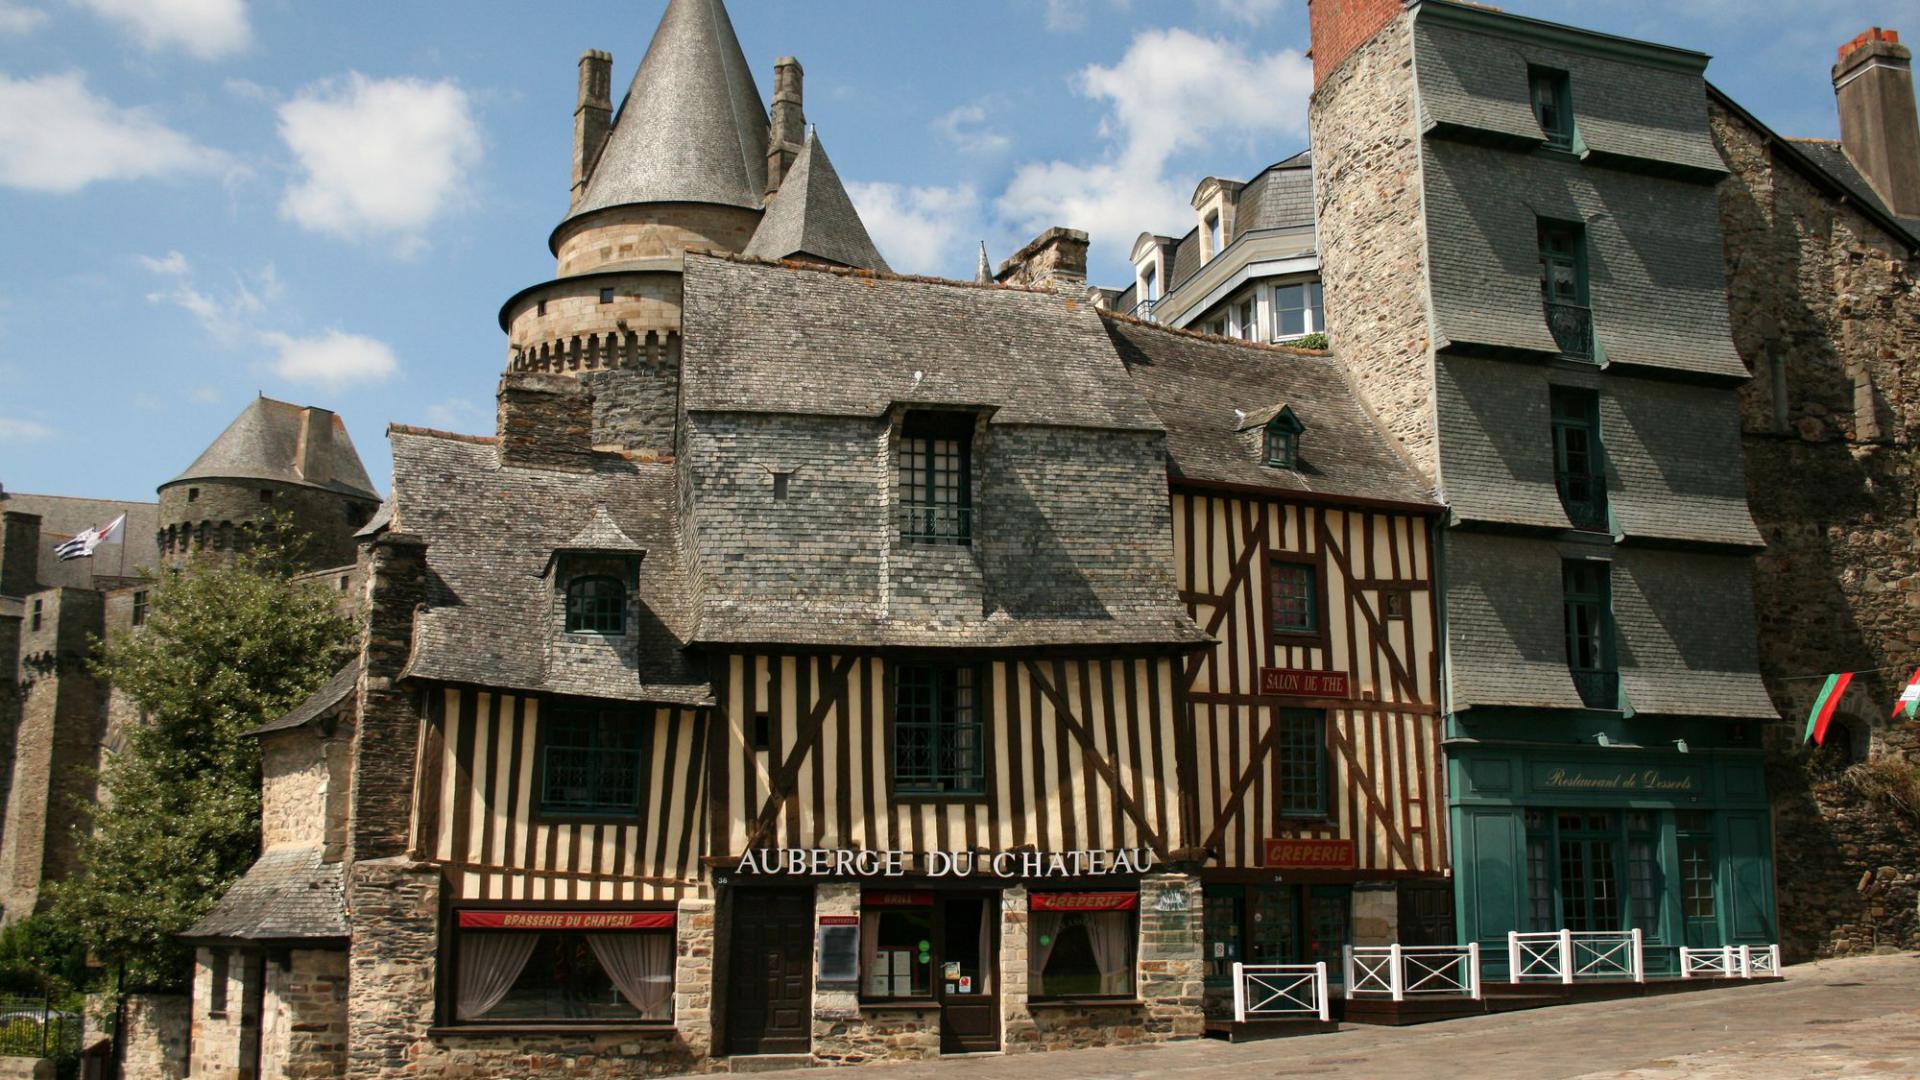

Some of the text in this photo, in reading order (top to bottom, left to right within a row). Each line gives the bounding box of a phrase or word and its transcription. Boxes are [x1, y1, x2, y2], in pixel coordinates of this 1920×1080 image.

[1266, 673, 1344, 692] SALON DE THE
[1545, 767, 1691, 790] Restaurant de Desserts
[1270, 845, 1349, 861] CREPERIE
[734, 847, 1155, 878] AUBERGE DU CHATEAU
[1044, 895, 1122, 907] CREPERIE
[503, 914, 633, 927] BRASSERIE DU CHATEAU
